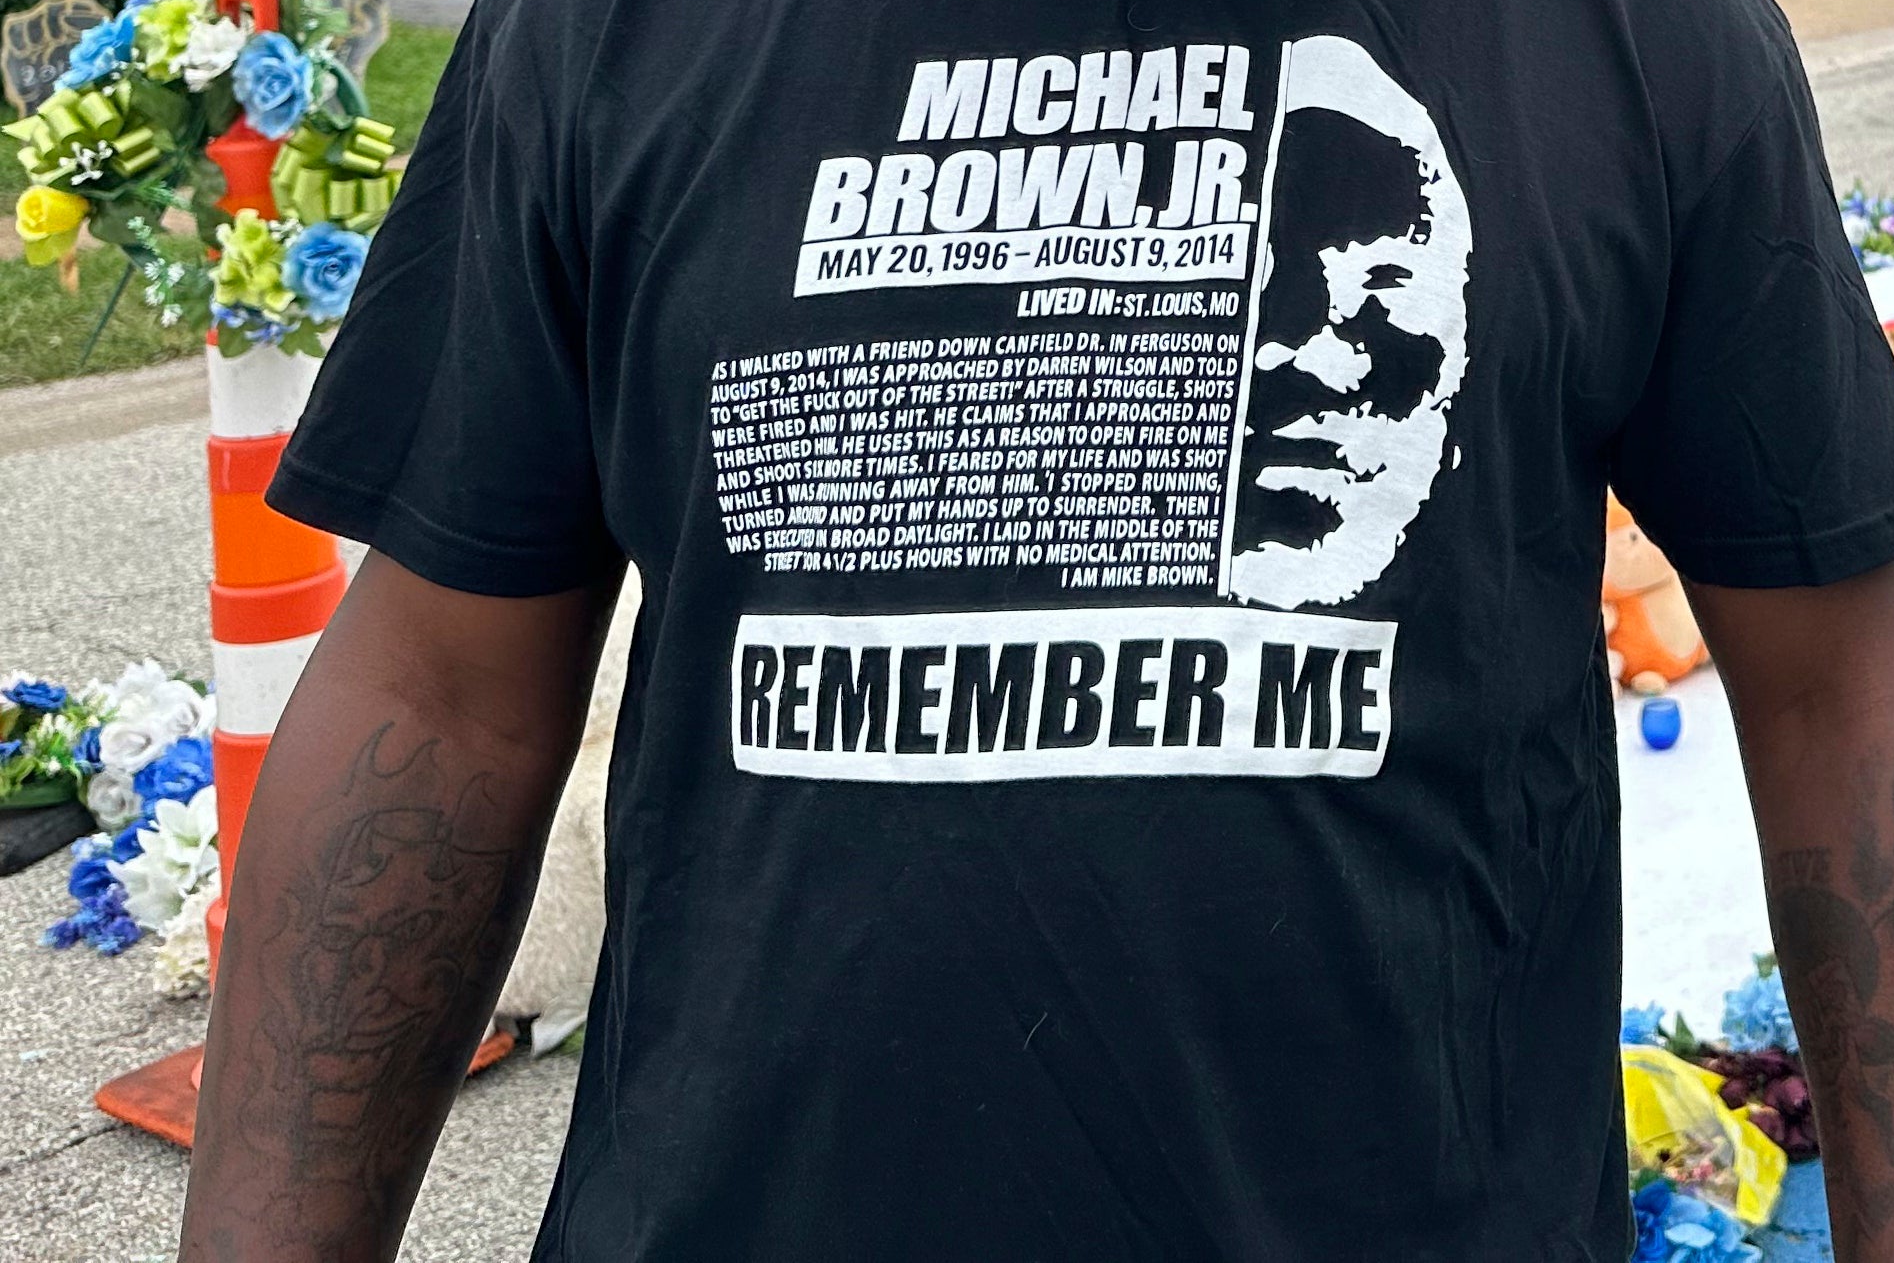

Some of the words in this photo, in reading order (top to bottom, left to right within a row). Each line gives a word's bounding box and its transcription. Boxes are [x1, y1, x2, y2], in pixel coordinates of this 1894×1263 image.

[897, 45, 1254, 141] MICHAEL
[803, 142, 1154, 241] BROWN,
[1157, 138, 1258, 227] JR.
[818, 246, 883, 280] MAY
[887, 244, 934, 278] 20,
[942, 242, 1010, 271] 1996
[1035, 236, 1146, 267] AUGUST
[1148, 238, 1170, 270] 9,
[1174, 234, 1234, 268] 2014
[1017, 287, 1087, 317] LIVED
[1088, 289, 1122, 316] IN:
[1123, 294, 1150, 318] ST.
[1209, 292, 1240, 317] MO
[712, 361, 727, 381] AS
[730, 360, 736, 378] I
[739, 351, 803, 377] WALKED
[807, 345, 850, 367] WITH
[852, 344, 865, 363] A
[869, 340, 934, 361] FRIEND
[938, 337, 991, 357] DOWN
[995, 333, 1073, 355] CANFIELD
[1076, 332, 1105, 352] DR.
[1109, 334, 1128, 353] IN
[1130, 333, 1214, 353] FERGUSON
[1217, 334, 1239, 353] ON
[710, 406, 731, 425] TO
[769, 396, 800, 417] THE
[803, 391, 841, 412] FUCK
[843, 388, 879, 409] OUT
[882, 386, 906, 407] OF
[910, 384, 943, 405] THE
[1024, 379, 1074, 399] AFTER
[1077, 379, 1087, 398] A
[1092, 378, 1179, 400] STRUGGLE,
[1183, 379, 1234, 399] SHOTS
[711, 378, 768, 403] AUGUST
[770, 377, 785, 396] 9,
[788, 371, 830, 393] 2014,
[833, 369, 839, 388] I
[843, 365, 880, 387] WAS
[882, 359, 999, 383] APPROACHED
[1001, 358, 1026, 377] BY
[1026, 356, 1091, 376] DARREN
[1095, 356, 1157, 376] WILSON
[1158, 356, 1194, 376] AND
[1197, 357, 1237, 377] TOLD
[712, 426, 756, 448] WERE
[759, 418, 806, 441] FIRED
[809, 414, 837, 434] AND
[839, 414, 845, 432] I
[850, 411, 890, 431] WAS
[894, 408, 928, 429] HIT.
[933, 406, 958, 427] HE
[962, 404, 1025, 425] CLAIMS
[1030, 402, 1072, 423] THAT
[1074, 402, 1081, 421] I
[1084, 402, 1193, 423] APPROACHED
[1196, 403, 1231, 422] AND
[713, 439, 812, 469] THREATENED
[842, 435, 866, 455] HE
[869, 432, 913, 454] USES
[916, 429, 954, 450] THIS
[957, 428, 981, 448] AS
[982, 428, 995, 447] A
[999, 426, 1065, 447] REASON
[1067, 425, 1088, 445] TO
[1090, 425, 1135, 445] OPEN
[1139, 426, 1175, 445] FIRE
[1177, 426, 1202, 445] ON
[1204, 426, 1229, 445] ME
[717, 470, 751, 491] AND
[754, 462, 801, 485] SHOOT
[804, 460, 824, 479] SIX
[866, 454, 923, 477] TIMES.
[928, 454, 934, 473] I
[938, 450, 1004, 473] FEARED
[1006, 449, 1038, 470] FOR
[1041, 449, 1068, 469] MY
[1069, 449, 1104, 468] LIFE
[1106, 449, 1143, 469] AND
[1146, 449, 1181, 468] WAS
[1184, 449, 1227, 468] SHOT
[718, 488, 772, 512] WHILE
[778, 486, 783, 503] I
[787, 483, 815, 502] WAS
[889, 477, 940, 499] AWAY
[945, 475, 996, 496] FROM
[1002, 473, 1039, 494] HIM.
[1061, 472, 1136, 492] STOPPED
[1142, 472, 1222, 494] RUNNING,
[722, 508, 785, 533] TURNED
[829, 505, 865, 525] AND
[869, 503, 905, 523] PUT
[907, 501, 935, 522] MY
[937, 498, 998, 520] HANDS
[1002, 497, 1024, 518] UP
[1027, 496, 1050, 518] TO
[1053, 496, 1156, 516] SURRENDER.
[1166, 496, 1209, 516] THEN
[1214, 496, 1220, 515] I
[726, 532, 761, 554] WAS
[815, 529, 827, 548] IN
[830, 527, 890, 549] BROAD
[894, 523, 979, 546] DAYLIGHT.
[983, 522, 990, 542] I
[993, 521, 1031, 542] LAID
[1035, 520, 1054, 541] IN
[1058, 520, 1091, 540] THE
[1094, 519, 1160, 540] MIDDLE
[1162, 519, 1184, 539] OF
[1187, 519, 1219, 538] THE
[822, 552, 831, 570] 4
[860, 550, 903, 571] PLUS
[906, 546, 963, 569] HOURS
[966, 545, 1010, 566] WITH
[1016, 544, 1042, 565] NO
[1045, 543, 1118, 564] MEDICAL
[1120, 542, 1215, 563] ATTENTION.
[1061, 568, 1068, 588] I
[1070, 567, 1098, 588] AM
[1101, 566, 1143, 587] MIKE
[1147, 565, 1213, 586] BROWN.
[740, 639, 1229, 754] REMEMBER
[1254, 642, 1382, 752] ME
